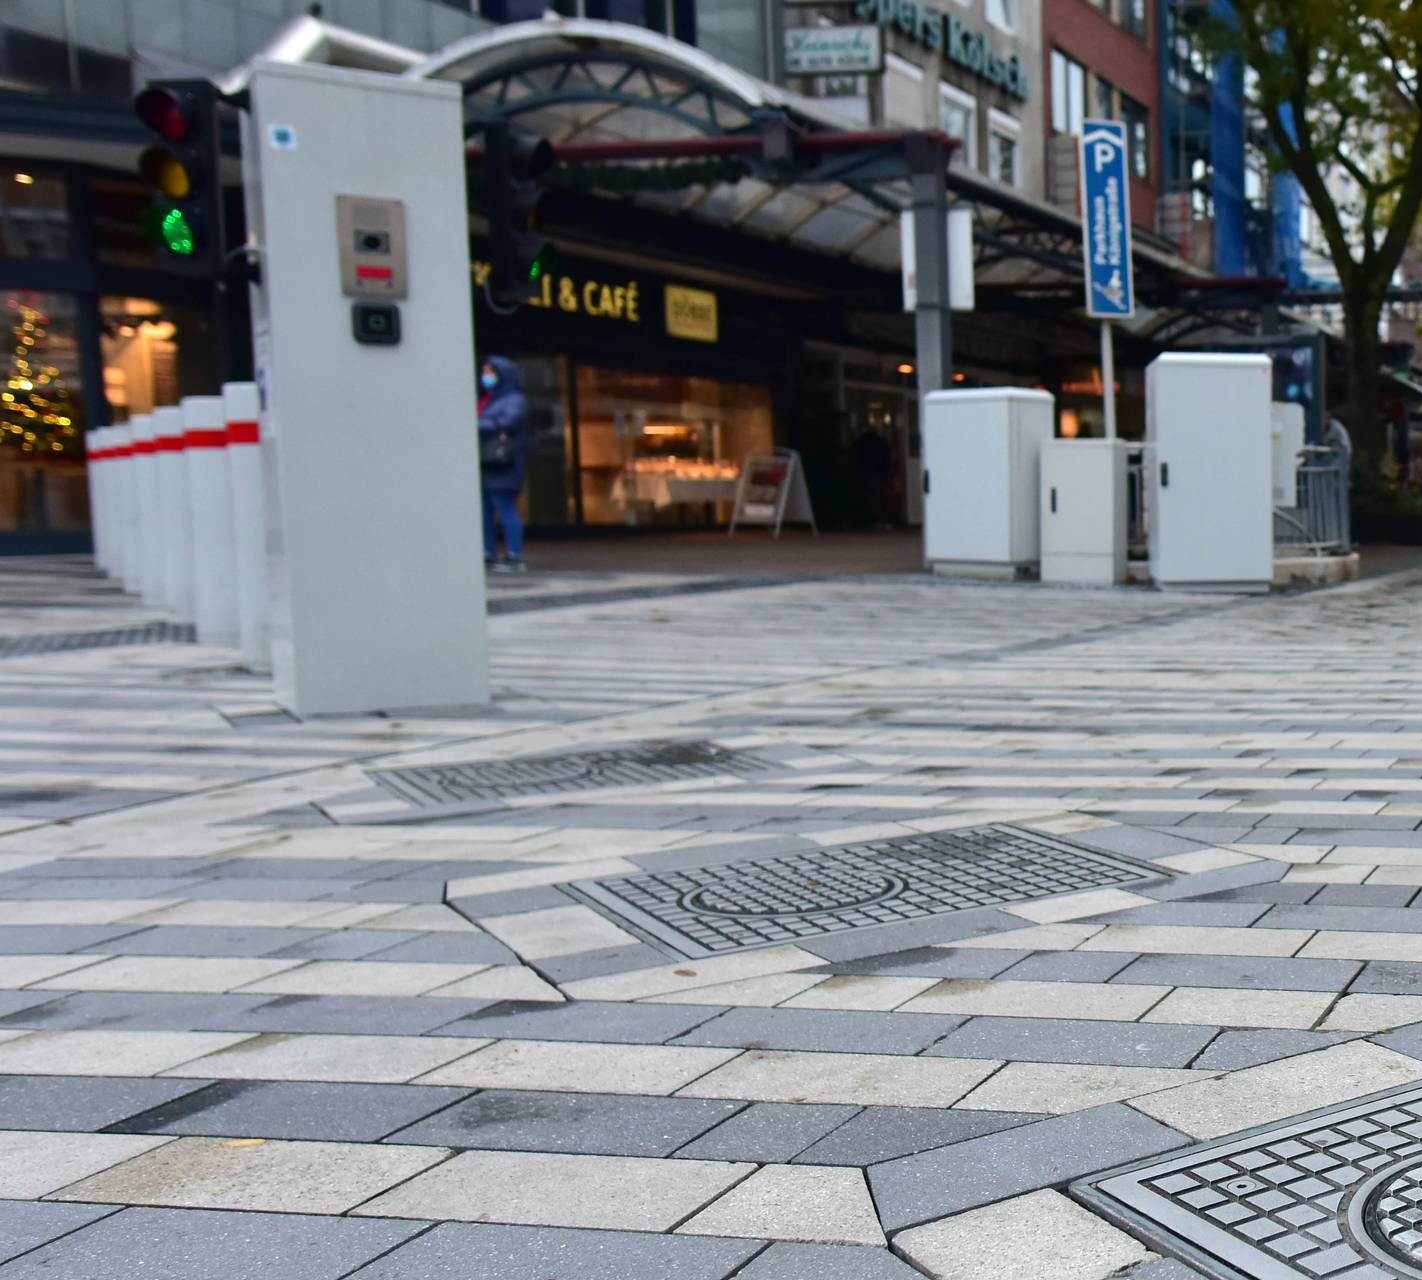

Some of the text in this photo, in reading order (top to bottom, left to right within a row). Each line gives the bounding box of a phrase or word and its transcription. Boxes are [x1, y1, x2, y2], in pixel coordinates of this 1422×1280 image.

[946, 14, 1028, 101] Kölsch
[1093, 142, 1116, 173] P
[1093, 195, 1107, 266] Parkhaus
[558, 275, 579, 313] &
[582, 280, 640, 322] CAFÉ
